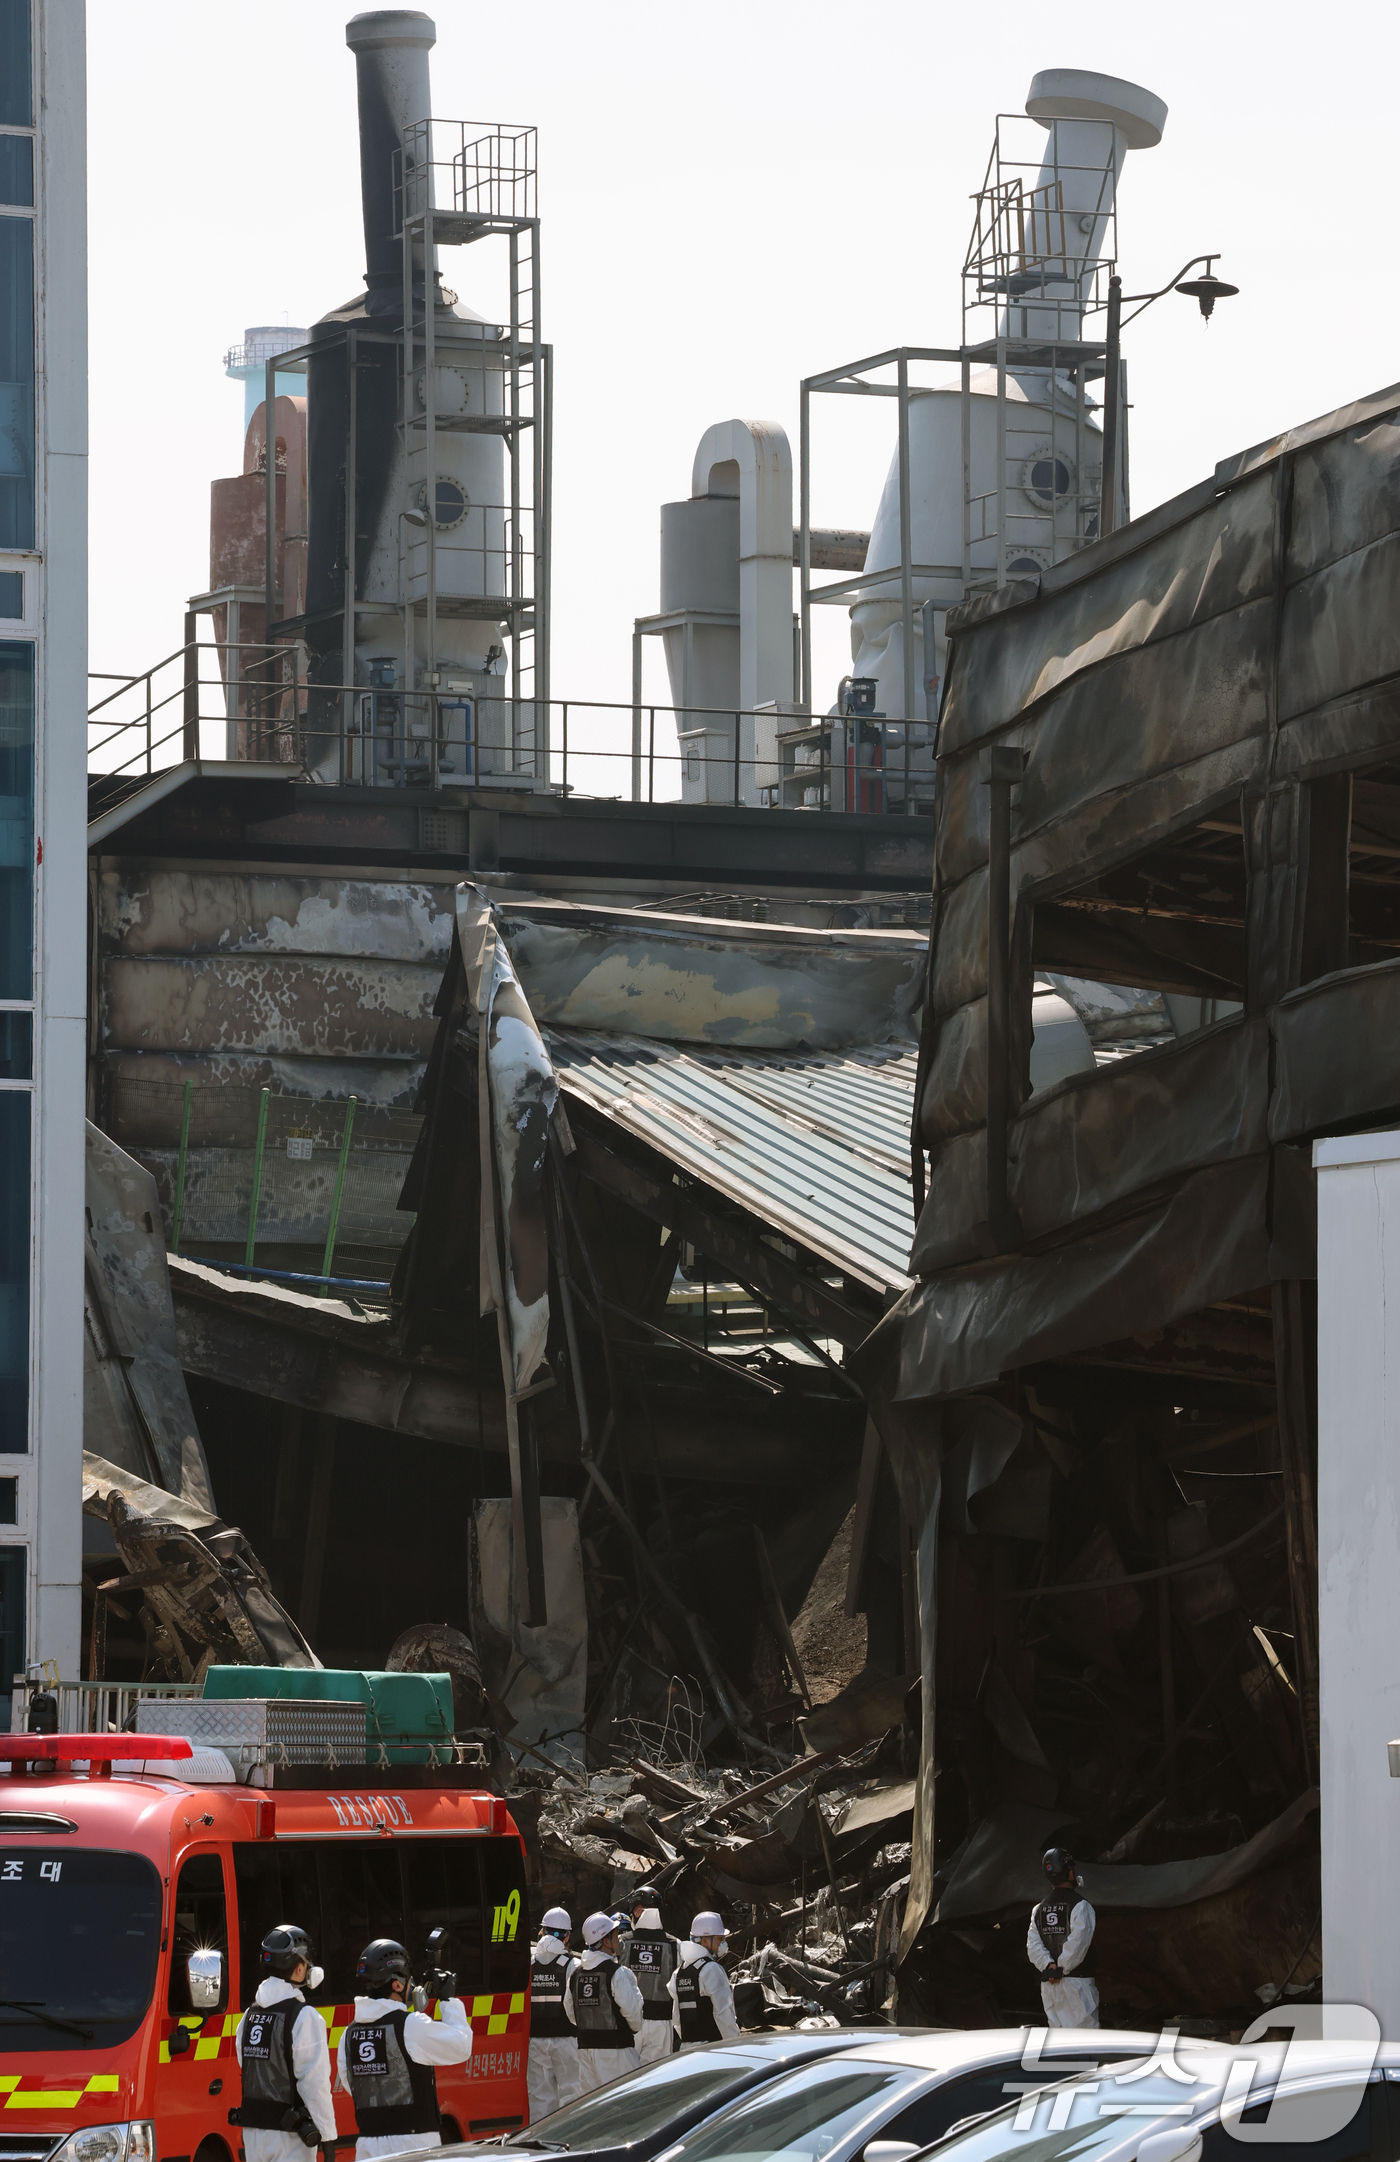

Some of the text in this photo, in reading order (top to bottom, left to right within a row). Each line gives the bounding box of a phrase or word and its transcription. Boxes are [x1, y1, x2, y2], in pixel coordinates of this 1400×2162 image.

[327, 1796, 413, 1826] RESCUE
[491, 1889, 520, 1942] 119
[249, 2014, 273, 2024] 사고조사
[352, 2030, 382, 2040] 사고조사
[465, 2051, 520, 2078] 대전대덕소방서
